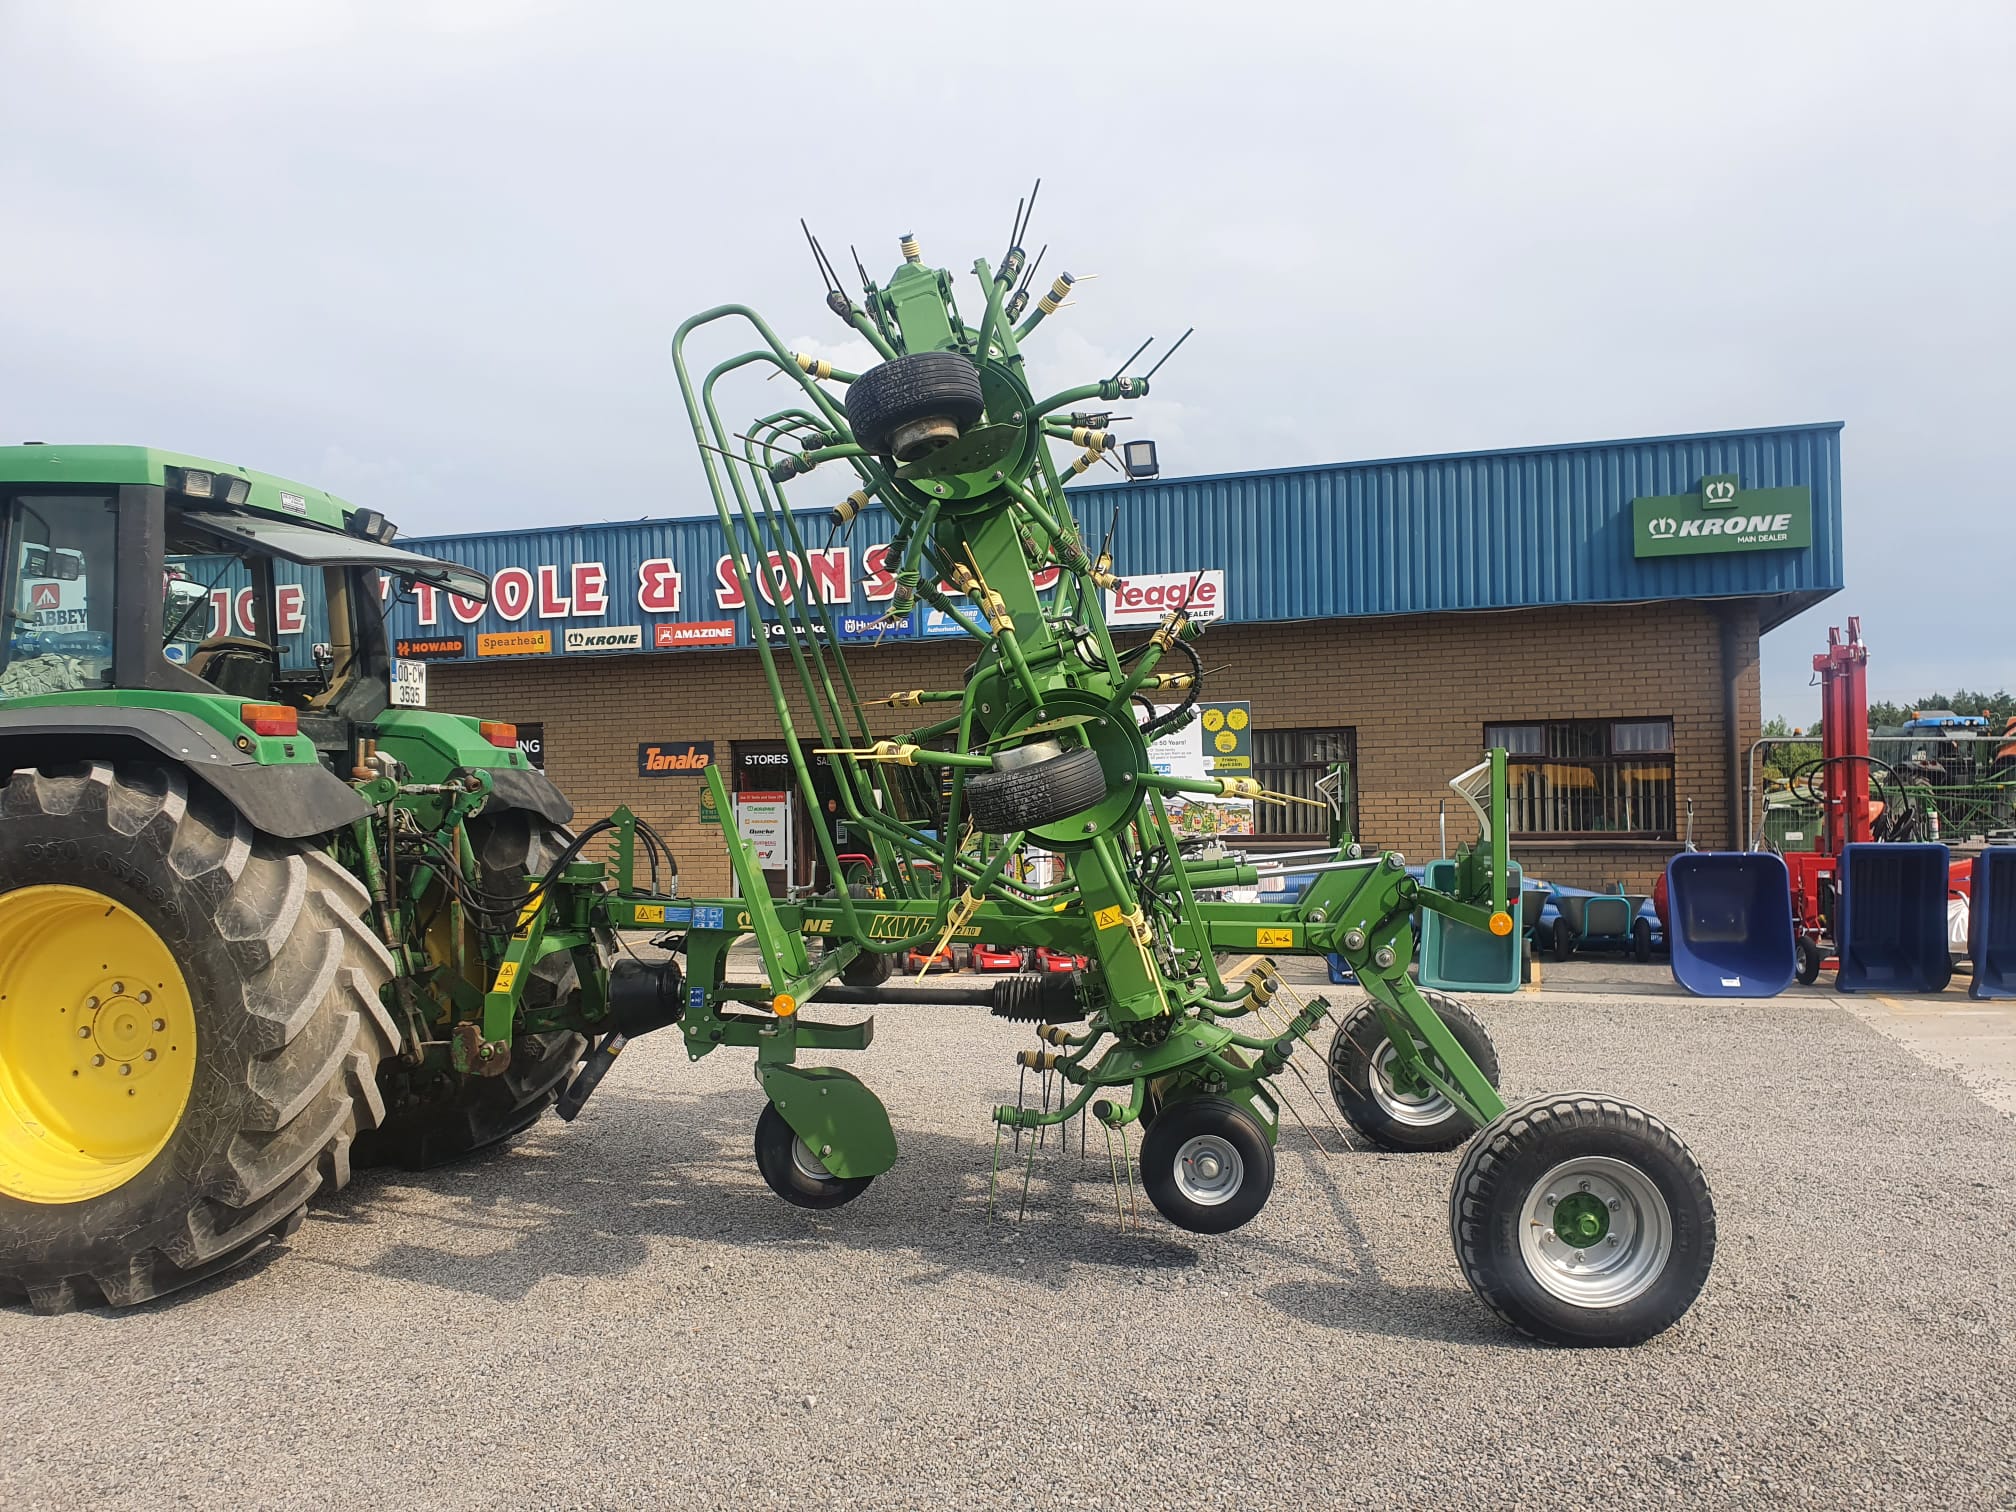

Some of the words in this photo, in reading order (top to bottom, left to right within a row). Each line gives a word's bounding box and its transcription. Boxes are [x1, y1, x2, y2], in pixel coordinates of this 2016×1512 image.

[1679, 513, 1792, 537] KRONE
[1737, 535, 1757, 544] MAIN
[1758, 533, 1788, 542] DEALER
[638, 557, 682, 613] &
[1114, 576, 1216, 610] Teagle
[32, 609, 87, 626] ABBEY
[1188, 610, 1214, 618] EALER
[585, 634, 638, 646] KRONE
[674, 627, 732, 640] AMAZONE
[412, 641, 462, 653] HOWARD
[484, 635, 544, 649] Spearhead
[400, 685, 420, 704] 3535
[646, 746, 709, 771] Tanaka
[745, 754, 789, 765] STORES
